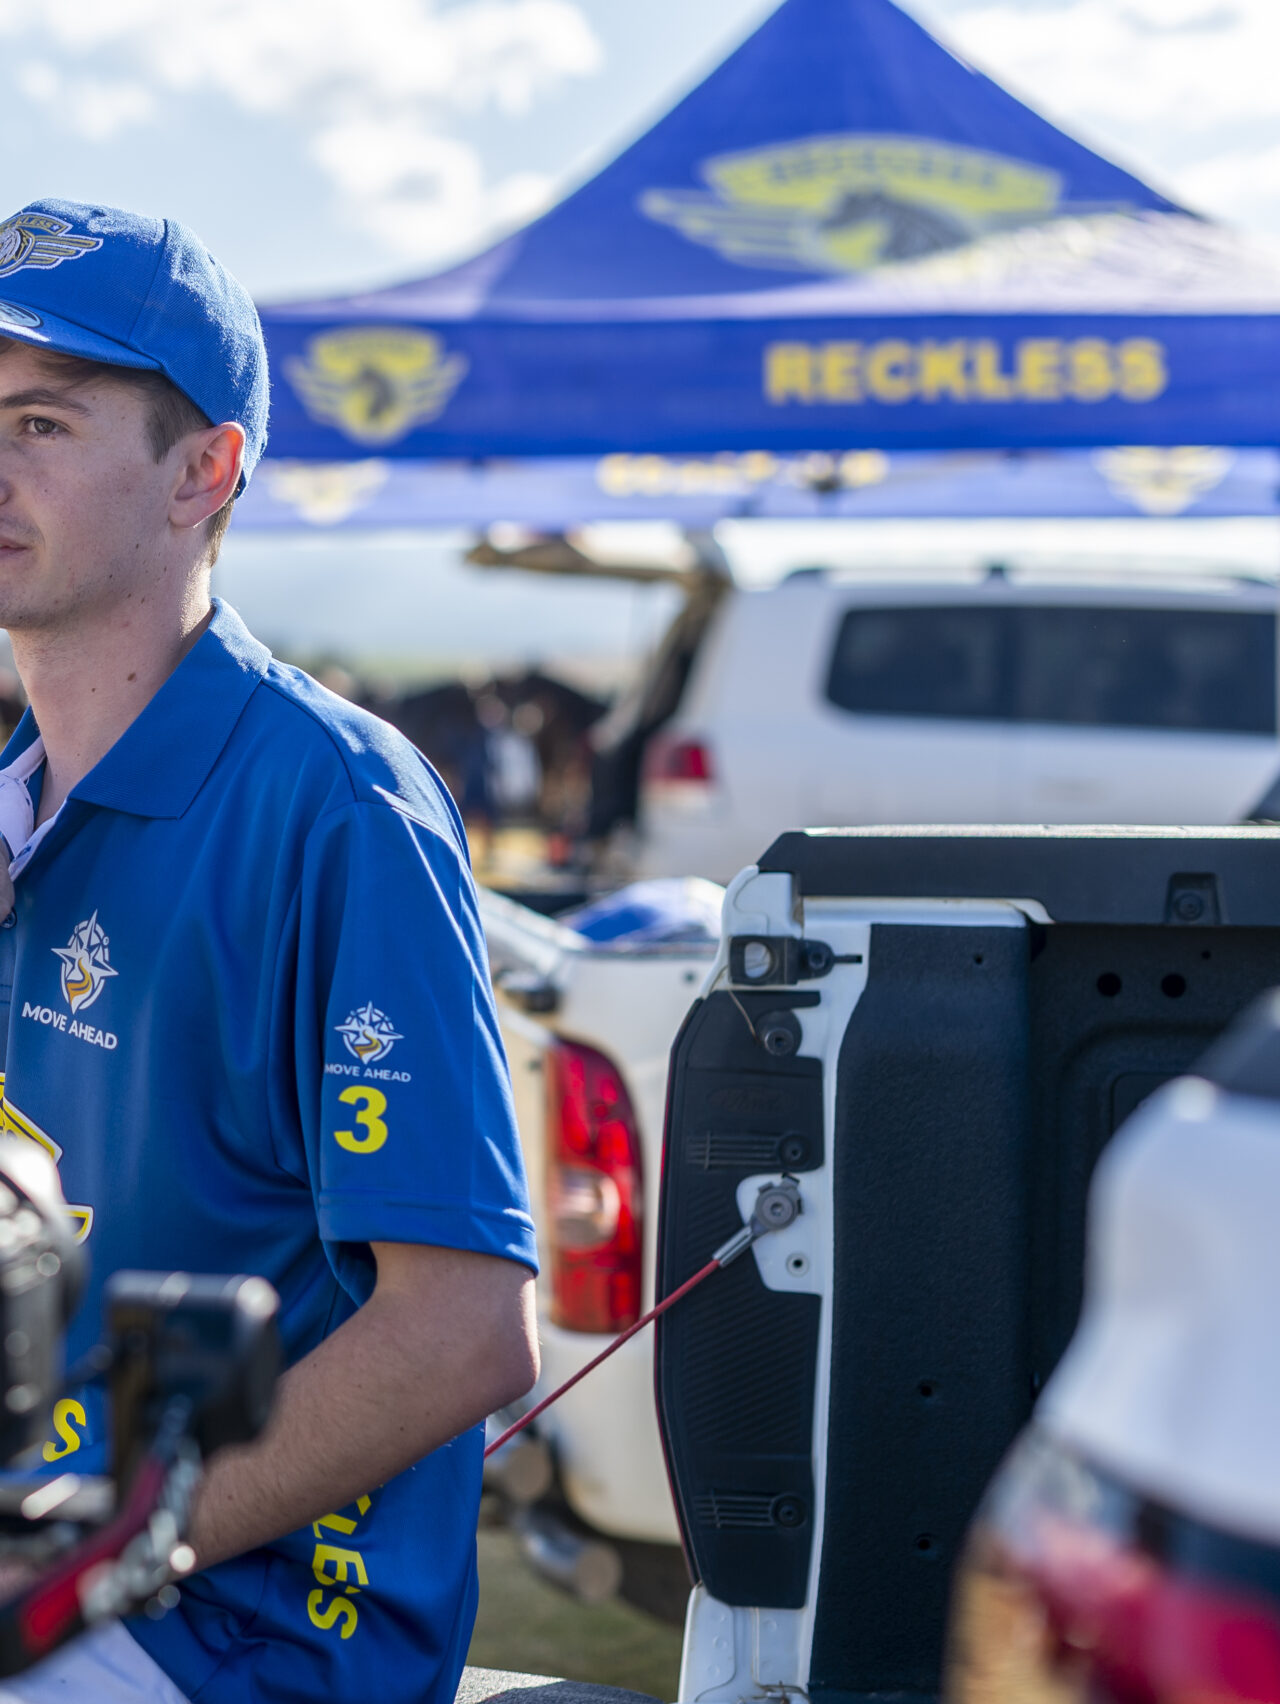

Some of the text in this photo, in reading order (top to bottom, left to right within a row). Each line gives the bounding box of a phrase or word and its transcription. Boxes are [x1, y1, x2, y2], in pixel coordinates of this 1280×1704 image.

[767, 340, 1164, 402] RECKLESS
[22, 1001, 118, 1050] MOVE AHEAD
[324, 1063, 412, 1083] MOVE AHEAD
[333, 1085, 388, 1154] 3
